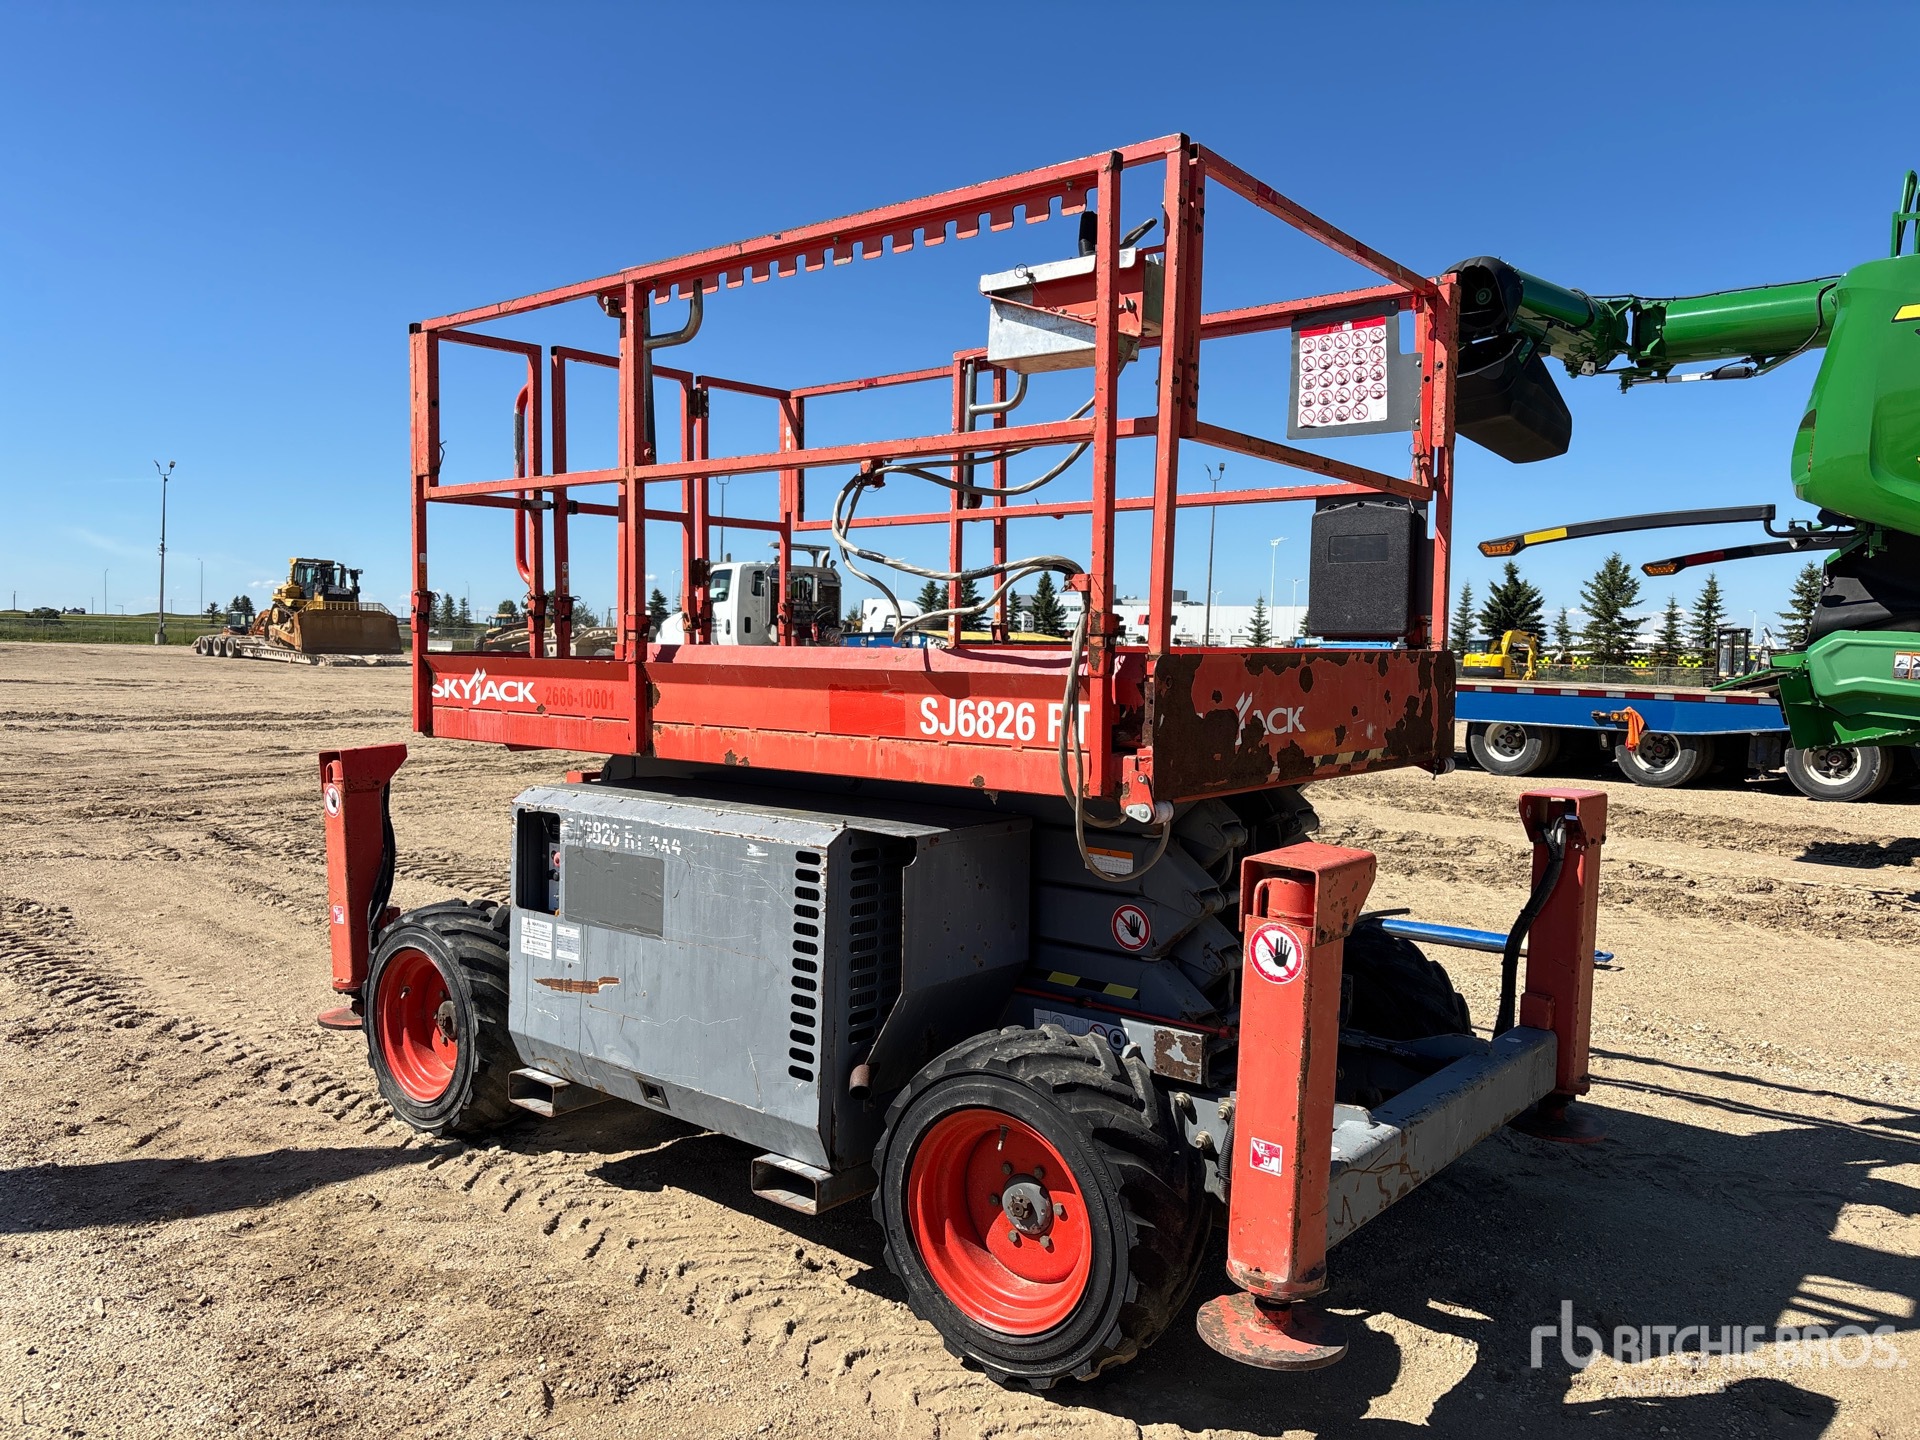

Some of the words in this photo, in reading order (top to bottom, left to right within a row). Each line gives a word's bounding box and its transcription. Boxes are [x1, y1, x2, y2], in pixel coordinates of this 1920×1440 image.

[431, 668, 538, 706] SKYJACK
[545, 686, 616, 711] 2666-10001
[919, 696, 1036, 741] SJ6826
[1047, 702, 1091, 744] RT
